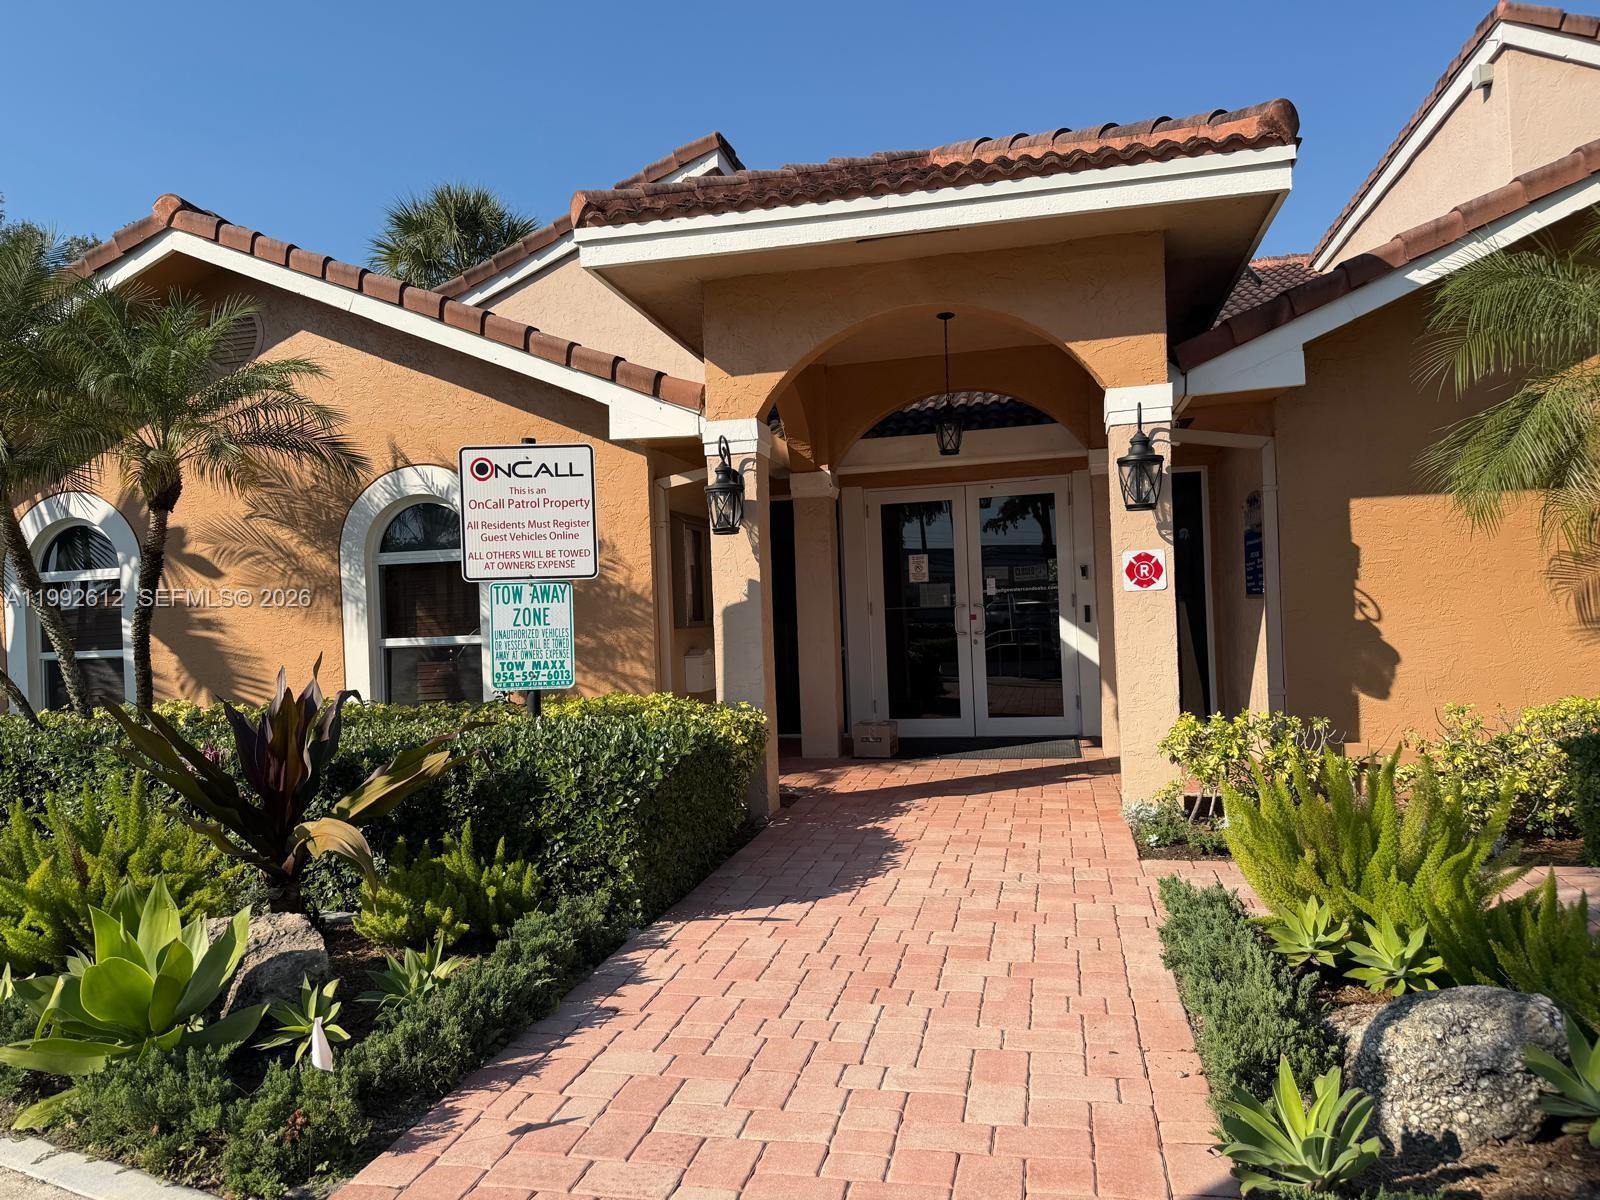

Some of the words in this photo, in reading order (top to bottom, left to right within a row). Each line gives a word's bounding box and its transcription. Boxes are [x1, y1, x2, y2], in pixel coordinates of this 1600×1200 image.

[468, 499, 505, 510] OnCall
[508, 498, 540, 508] Patrol
[543, 498, 590, 510] Property
[466, 521, 479, 530] All
[481, 520, 526, 530] Residents
[528, 520, 550, 528] Must
[552, 520, 590, 530] Register
[480, 533, 507, 542] Guest
[509, 532, 548, 541] Vehicles
[549, 532, 580, 540] Online
[468, 552, 484, 560] ALL
[486, 550, 520, 560] OTHERS
[522, 550, 543, 558] WILL
[545, 550, 556, 558] BE
[558, 549, 590, 558] TOWED
[484, 561, 494, 570] AT
[497, 560, 536, 570] OWNERS
[538, 560, 576, 568] EXPENSE
[1140, 564, 1150, 576] R
[493, 586, 523, 604] TOW
[531, 584, 567, 604] AWAY
[513, 608, 550, 626] ZONE
[494, 629, 539, 640] UNAUTHORIZED
[542, 628, 570, 638] VEHICLES
[494, 640, 502, 650] OR
[504, 640, 528, 650] VESSELS
[530, 639, 542, 650] WILL
[544, 638, 550, 649] BE
[552, 638, 570, 648] TOWED
[496, 650, 510, 660] AWAY
[512, 650, 518, 660] AT
[520, 650, 544, 660] OWNERS
[546, 649, 570, 658] EXPENSE
[500, 662, 526, 671] TOW
[532, 660, 566, 670] MAXX
[495, 670, 570, 682] 954-597-6013
